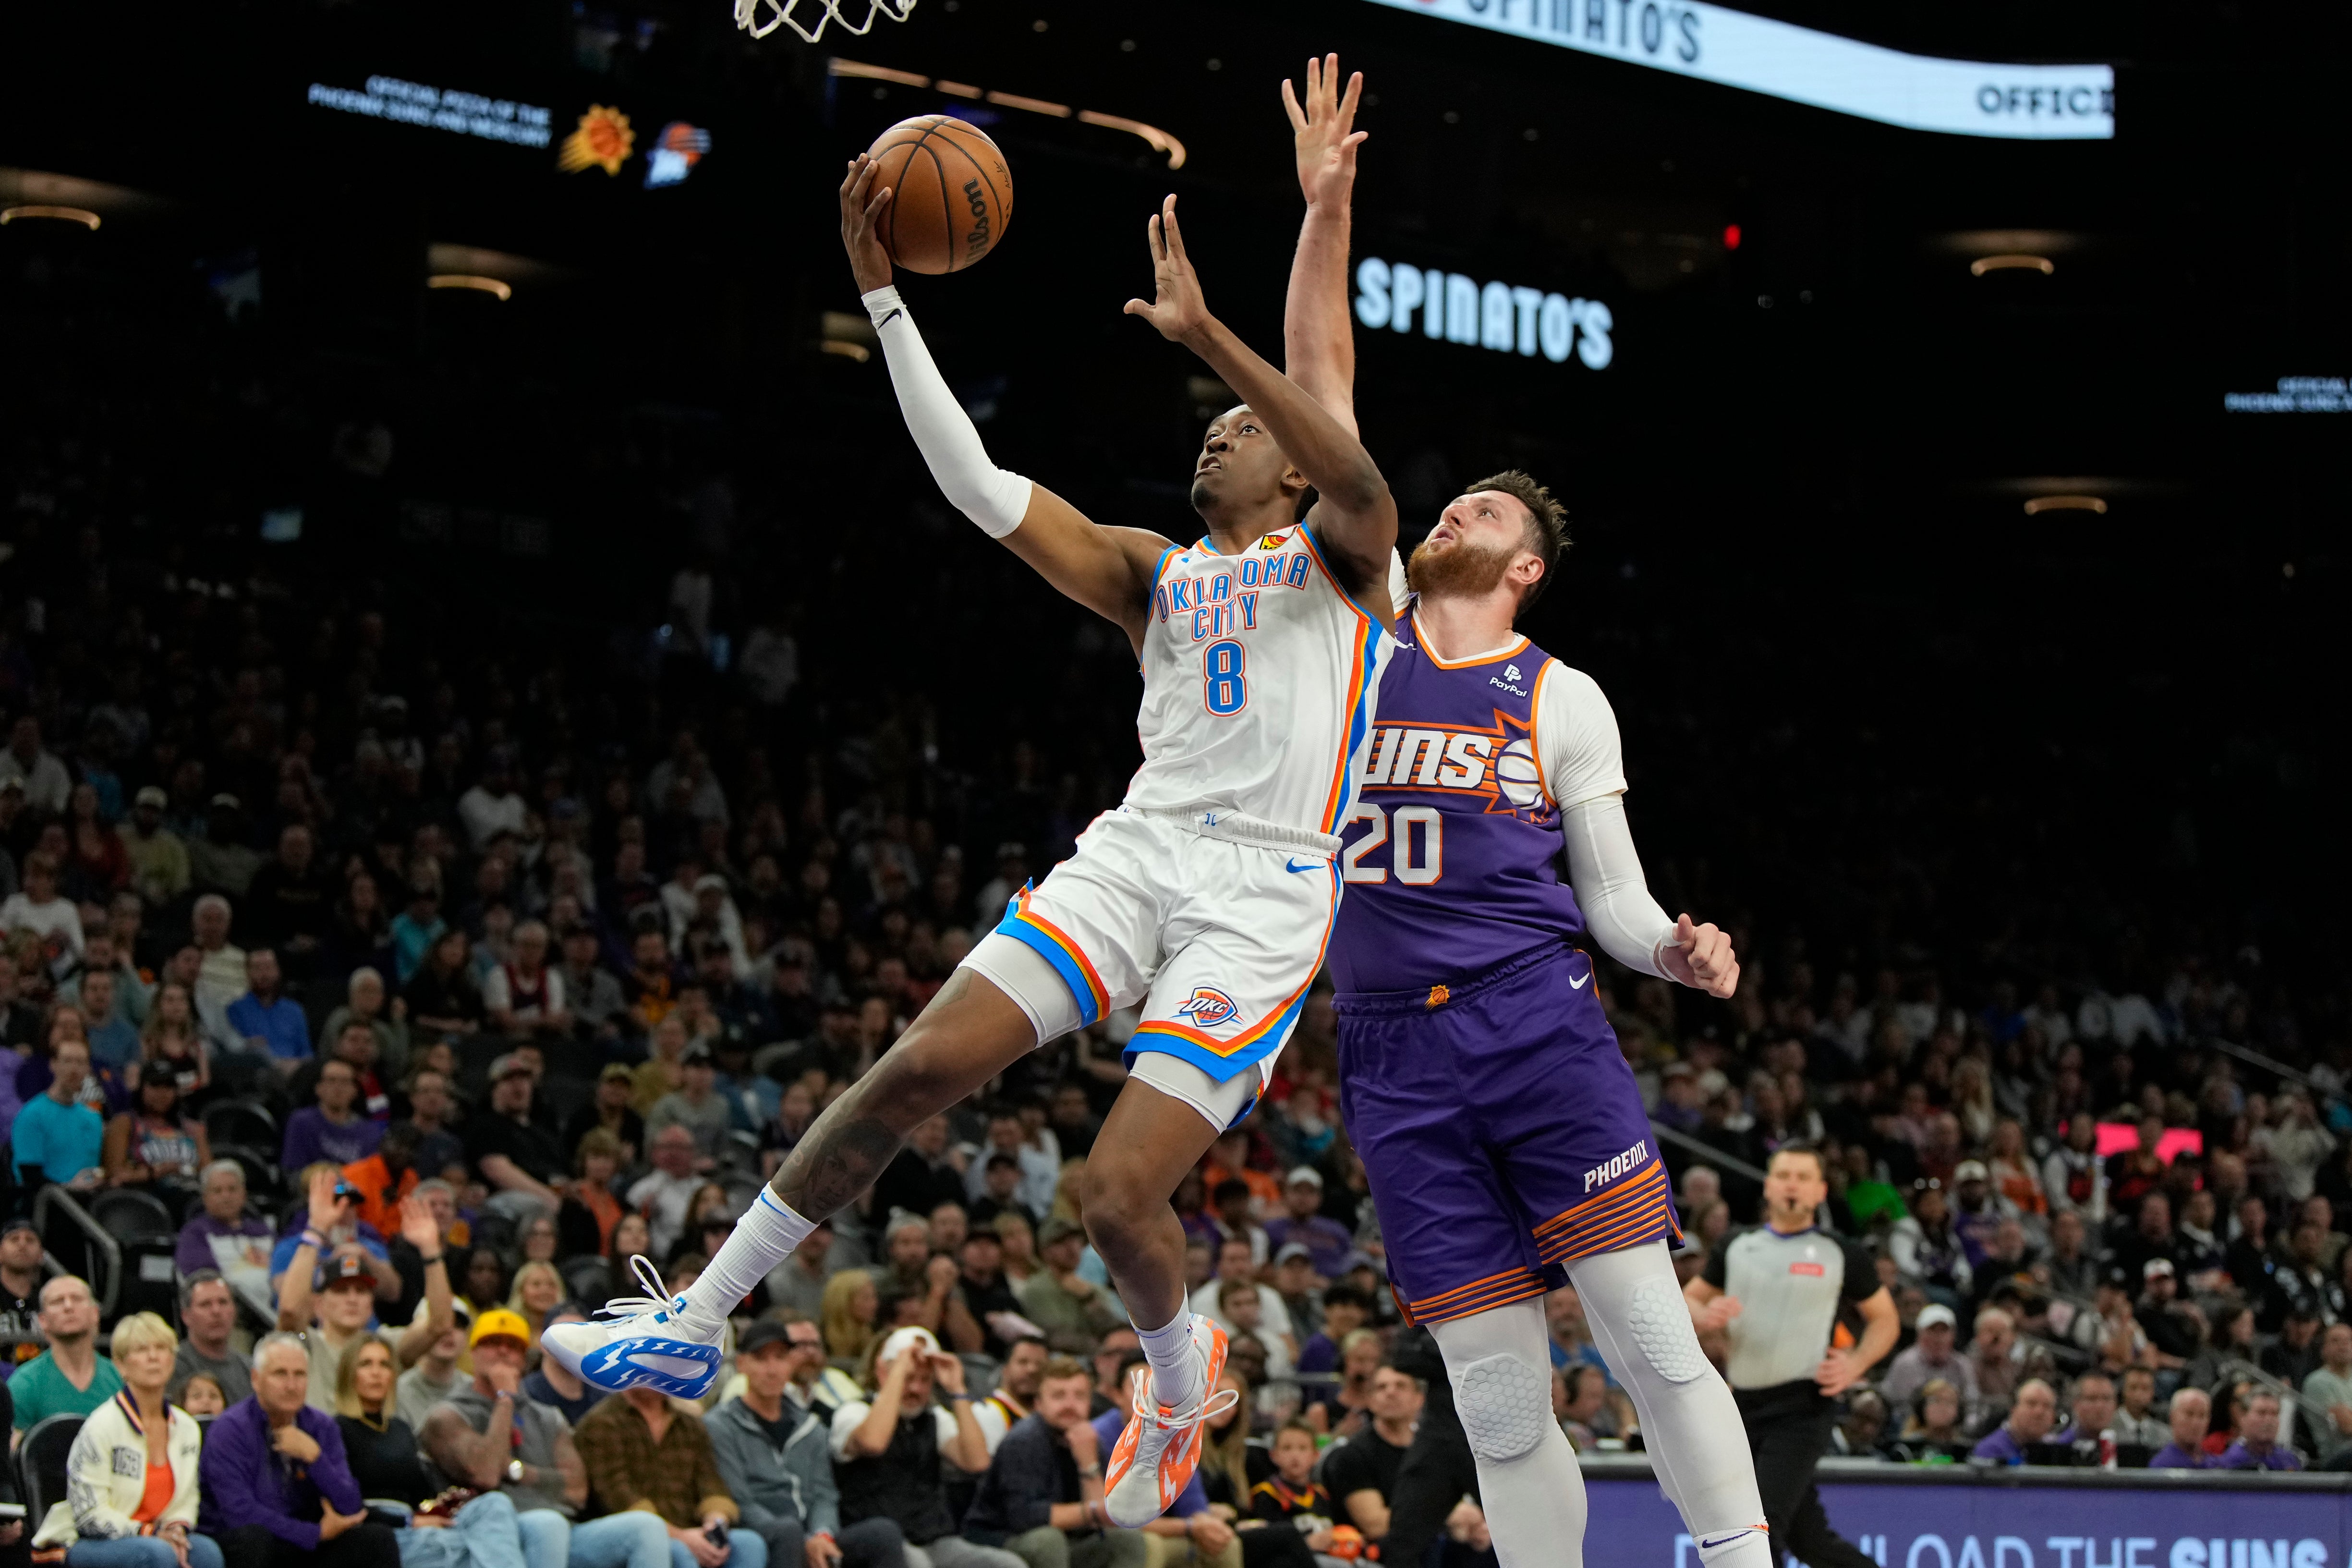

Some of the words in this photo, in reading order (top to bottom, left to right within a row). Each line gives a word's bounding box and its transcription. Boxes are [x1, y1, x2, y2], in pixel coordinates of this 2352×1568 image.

[1466, 0, 1700, 63] INATO'S
[1355, 256, 1613, 370] SPINATO'S
[1154, 552, 1312, 623] OKLAOMA
[1191, 591, 1259, 642] CITY
[1203, 639, 1248, 717] 8
[1489, 677, 1528, 697] PayPal
[1362, 728, 1492, 789] UNS
[1343, 802, 1443, 886] 20
[1584, 1140, 1649, 1194] PHOENIX
